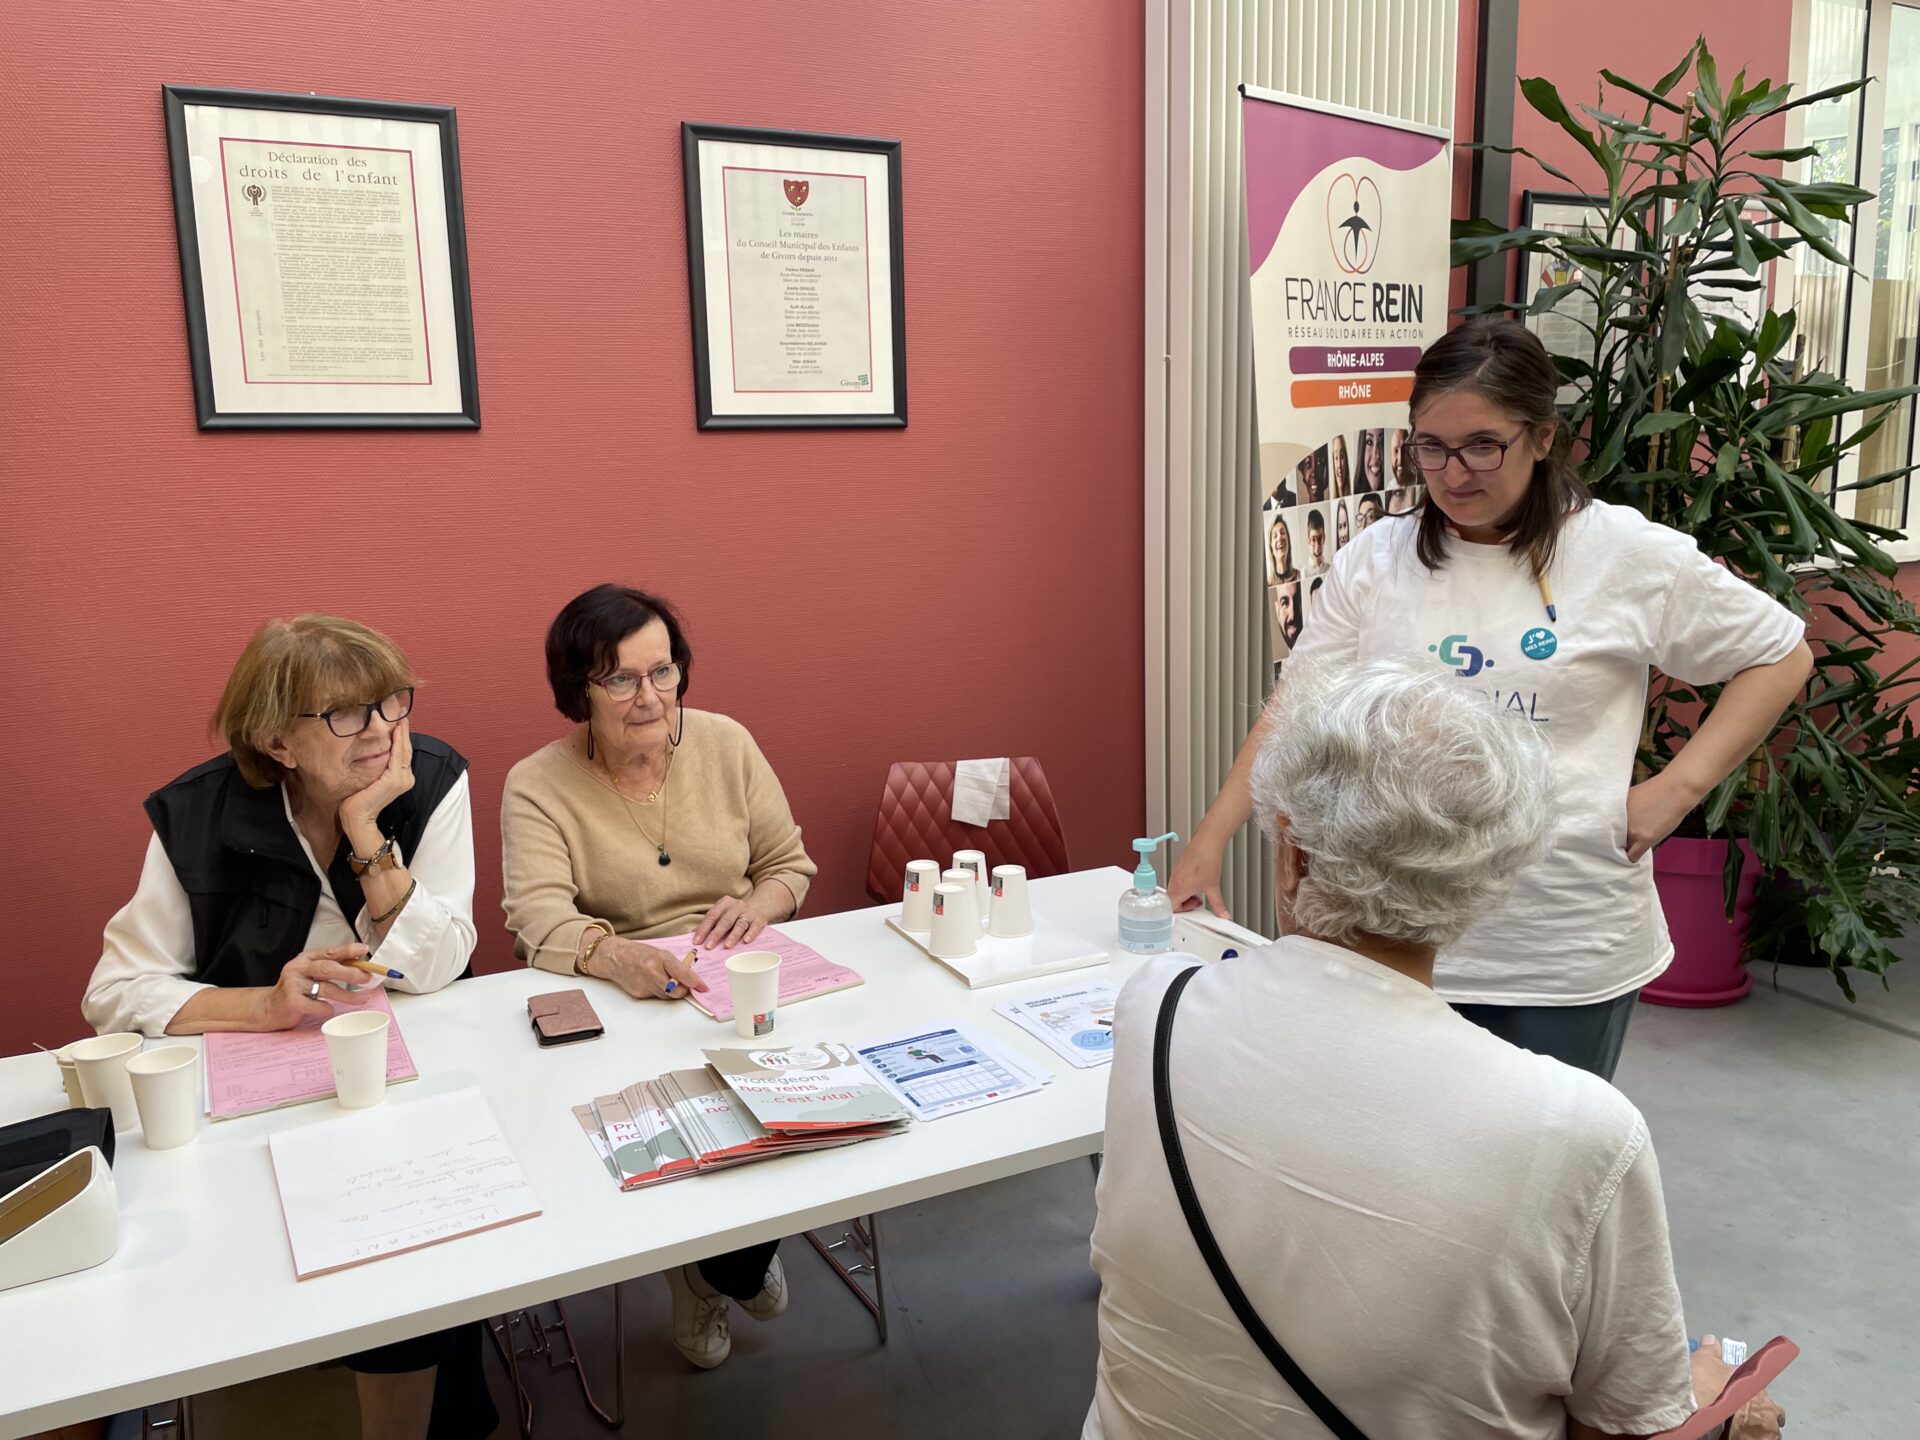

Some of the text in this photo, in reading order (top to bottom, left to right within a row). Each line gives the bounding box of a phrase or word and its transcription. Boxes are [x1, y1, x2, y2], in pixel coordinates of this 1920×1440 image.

[268, 151, 367, 168] Déclaration des
[239, 165, 398, 186] droits de l'enfant
[779, 230, 818, 239] Les maires
[736, 239, 859, 252] du Conseil Municipal des Enfants
[760, 251, 770, 259] de
[772, 251, 796, 260] Givors
[799, 252, 822, 263] depuis
[1285, 277, 1423, 323] FRANCE REIN
[1288, 325, 1424, 339] RÉSEAU SOLIDAIRE EN ACTION
[1327, 350, 1384, 367] RHÔNE-ALPES
[1338, 381, 1371, 399] RHÔNE
[738, 1085, 771, 1093] nos
[816, 1091, 855, 1102] vital
